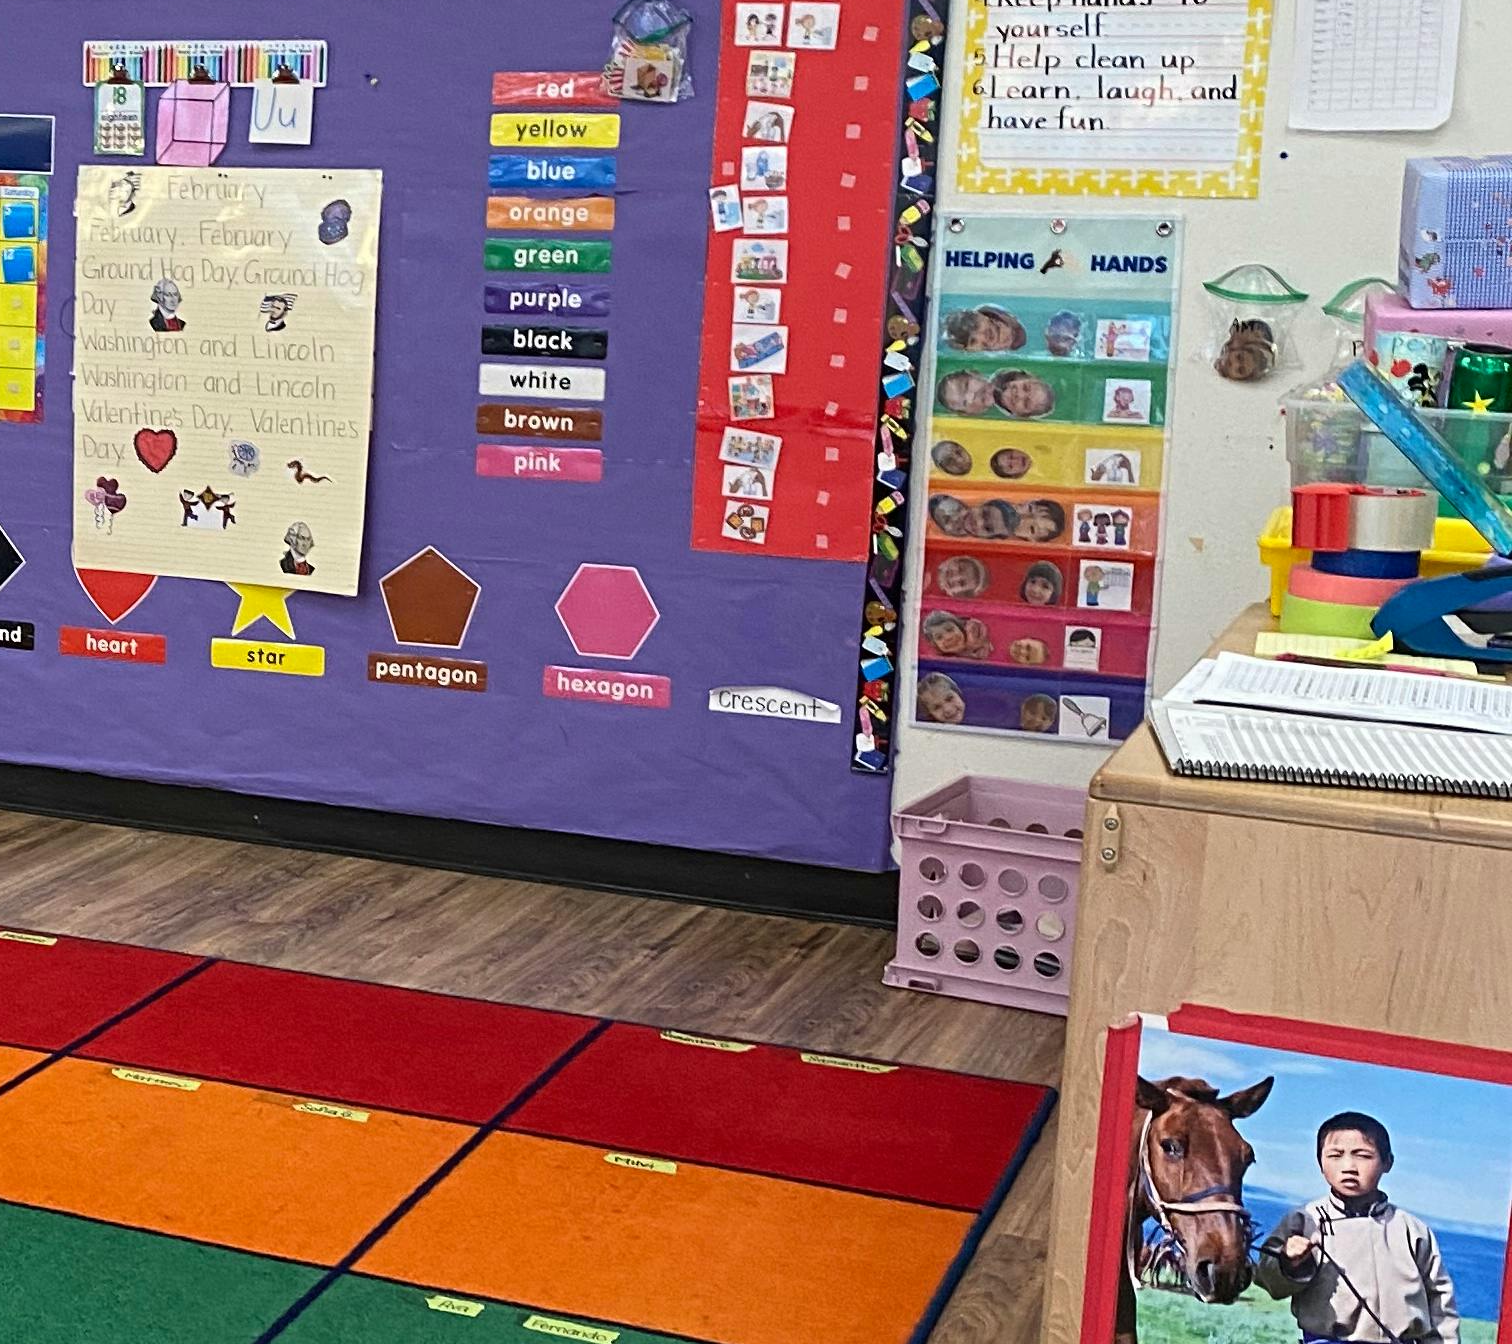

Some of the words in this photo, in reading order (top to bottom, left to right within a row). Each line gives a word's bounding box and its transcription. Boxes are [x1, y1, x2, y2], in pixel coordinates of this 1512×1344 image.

[993, 44, 1062, 75] Help
[1075, 43, 1146, 69] clean
[112, 86, 128, 106] 18
[536, 79, 575, 99] red
[1191, 74, 1238, 101] and
[987, 105, 1049, 131] have
[516, 119, 588, 142] yellow
[525, 160, 577, 182] blue
[509, 203, 589, 227] orange
[513, 246, 580, 269] green
[945, 250, 1035, 271] HELPING
[1090, 254, 1169, 274] HANDS
[82, 255, 154, 281] Ground
[243, 259, 318, 287] Ground
[509, 287, 583, 312] purple
[79, 328, 189, 360] Washington
[199, 336, 237, 357] and
[252, 336, 335, 362] Lincoln
[513, 328, 574, 352] black
[81, 363, 189, 395] Washington
[203, 372, 241, 394] and
[257, 373, 337, 400] Lincoln
[509, 371, 571, 392] white
[503, 411, 574, 432] brown
[514, 450, 561, 474] pink
[85, 634, 139, 656] heart
[246, 648, 286, 667] star
[375, 656, 478, 687] pentagon
[557, 674, 655, 701] hexagon
[531, 1319, 608, 1342] Fernando
